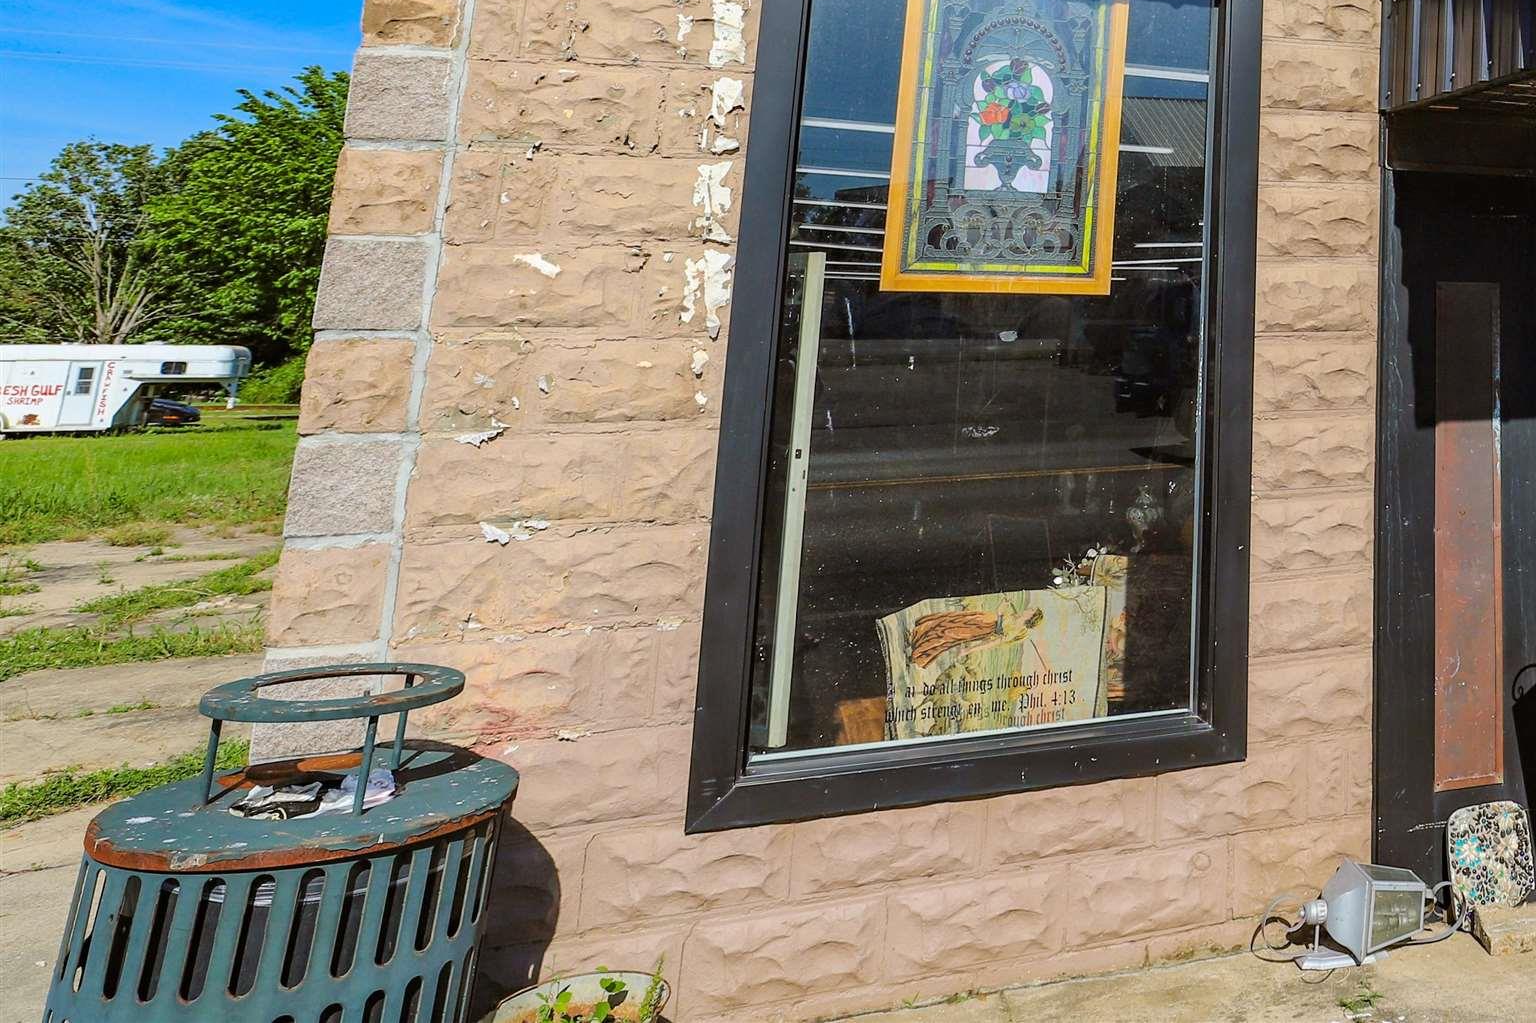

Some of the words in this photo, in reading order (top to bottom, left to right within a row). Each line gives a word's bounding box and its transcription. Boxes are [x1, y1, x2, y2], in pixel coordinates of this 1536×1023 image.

[0, 385, 28, 396] ESH
[31, 384, 63, 396] GULF
[6, 397, 44, 406] SHRIMP
[940, 678, 954, 694] all
[997, 671, 1040, 690] through
[1042, 669, 1073, 685] christ
[1051, 689, 1076, 706] 4:13
